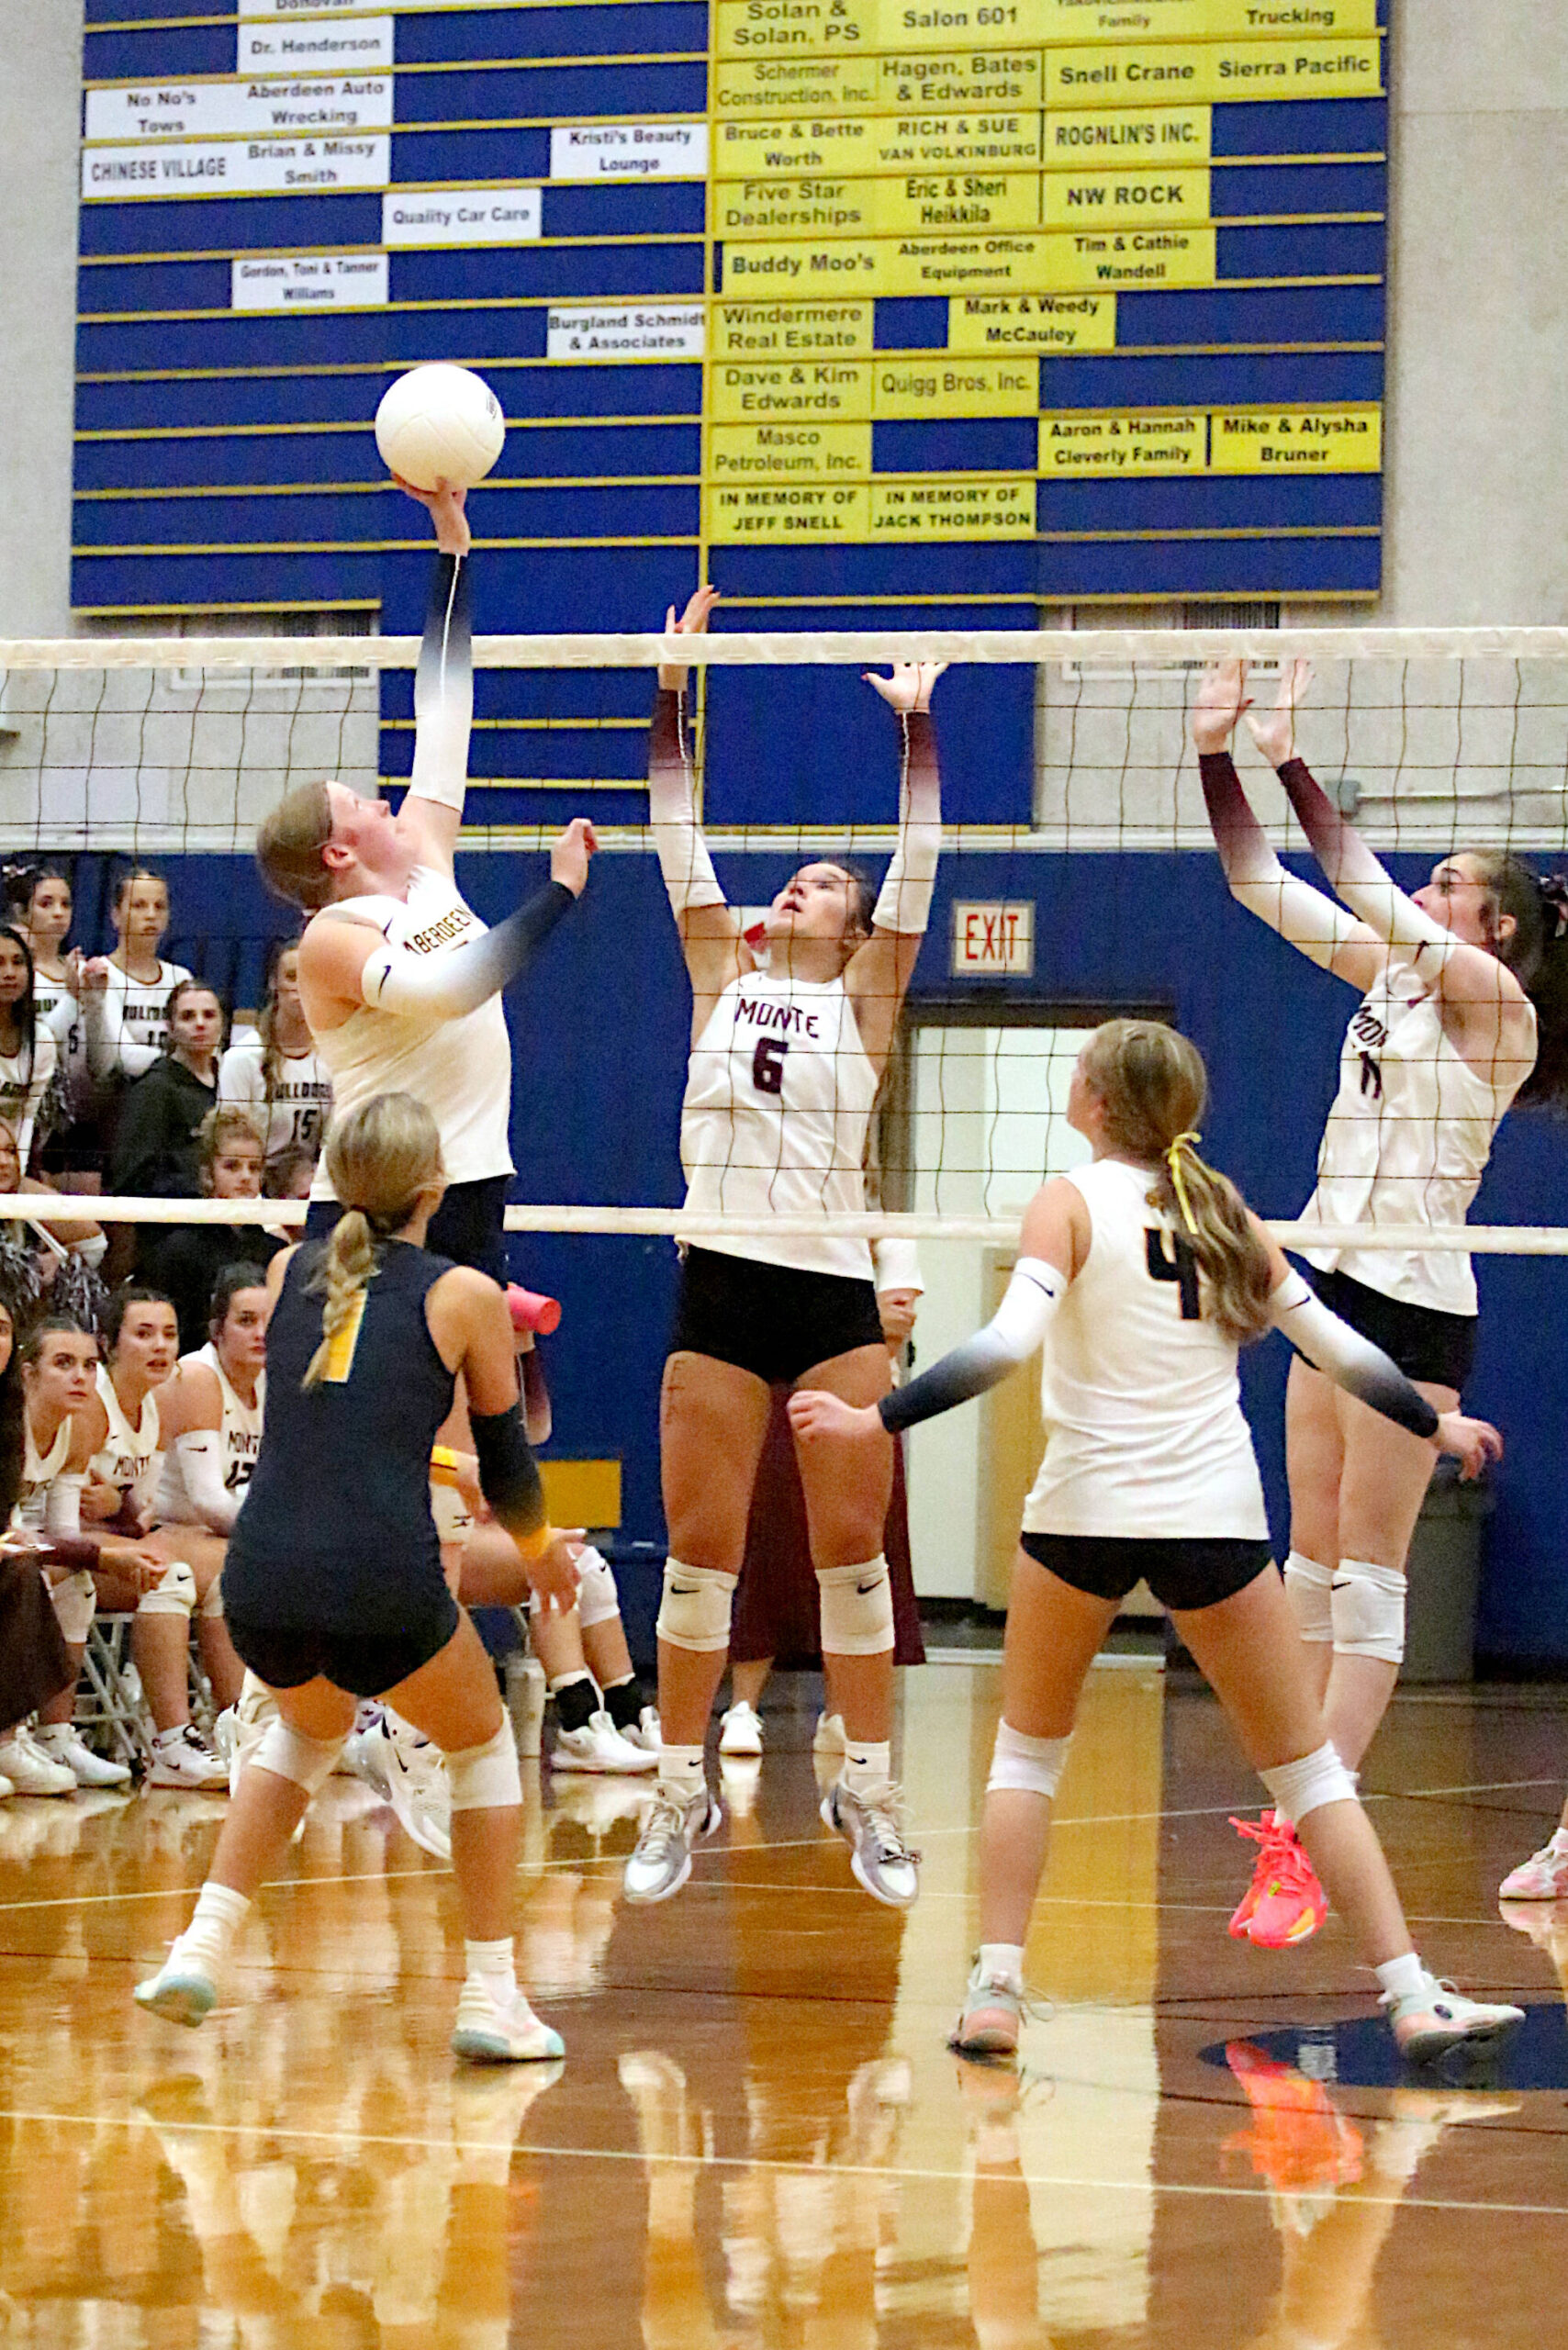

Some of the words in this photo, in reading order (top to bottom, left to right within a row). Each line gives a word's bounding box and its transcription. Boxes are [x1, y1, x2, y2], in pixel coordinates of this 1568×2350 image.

[747, 1, 821, 20] Solan
[829, 0, 847, 17] &
[903, 10, 969, 28] Salon
[977, 7, 1018, 25] 601
[1247, 9, 1335, 26] Trucking
[824, 24, 860, 41] PS
[251, 41, 274, 55] Dr.
[281, 38, 381, 54] Henderson
[755, 62, 840, 81] Schermer
[971, 56, 1036, 73] Bates
[1219, 61, 1286, 78] Sierra
[1294, 56, 1371, 73] Pacific
[1060, 66, 1117, 84] Snell
[1126, 64, 1195, 82] Crane
[248, 84, 335, 98] Aberdeen
[342, 82, 385, 95] Auto
[897, 85, 912, 102] &
[921, 83, 1024, 101] Edwards
[127, 95, 151, 107] No
[158, 92, 196, 106] No's
[138, 119, 185, 133] Tows
[271, 110, 358, 126] Wrecking
[725, 125, 782, 140] Bruce
[790, 124, 803, 138] &
[811, 123, 864, 138] Bette
[898, 121, 947, 136] RICH
[957, 120, 969, 135] &
[978, 118, 1019, 133] SUE
[1056, 125, 1155, 146] ROGNLIN'S
[1162, 123, 1199, 143] INC.
[569, 130, 627, 146] Kristi's
[633, 129, 691, 145] Beauty
[248, 144, 297, 160] Brian
[304, 144, 316, 157] &
[323, 142, 375, 158] Missy
[765, 151, 823, 166] Worth
[879, 148, 914, 161] VAN
[921, 143, 1036, 160] VOLKINBURG
[92, 160, 156, 182] CHINESE
[162, 157, 226, 178] VILLAGE
[599, 157, 660, 174] Lounge
[285, 170, 337, 184] Smith
[744, 185, 790, 201] Five
[798, 184, 844, 199] Star
[906, 179, 938, 198] Eric
[945, 179, 957, 196] &
[964, 178, 1007, 197] Sheri
[1067, 188, 1106, 206] NW
[1114, 185, 1183, 204] ROCK
[393, 209, 452, 227] Quality
[457, 208, 486, 222] Car
[491, 207, 531, 221] Care
[726, 208, 862, 227] Dealerships
[921, 205, 991, 225] Heikkila
[899, 241, 979, 256] Aberdeen
[985, 240, 1035, 253] Office
[1074, 237, 1106, 252] Tim
[1113, 237, 1126, 252] &
[1132, 235, 1189, 252] Cathie
[294, 263, 319, 274] Toni
[322, 263, 331, 274] &
[336, 261, 378, 274] Tanner
[732, 255, 801, 276] Buddy
[810, 252, 875, 271] Moo's
[921, 264, 1011, 281] Equipment
[1096, 263, 1166, 279] Wandell
[283, 287, 335, 300] Williams
[965, 299, 1010, 315] Mark
[1019, 298, 1031, 313] &
[634, 313, 706, 327] Schmidt
[722, 308, 862, 323] Windermere
[569, 337, 582, 350] &
[588, 335, 686, 351] Associates
[728, 332, 777, 349] Real
[786, 330, 857, 348] Estate
[986, 327, 1077, 344] McCauley
[725, 369, 781, 386] Dave
[790, 368, 805, 386] &
[814, 367, 858, 384] Kim
[881, 373, 936, 396] Quigg
[742, 393, 841, 410] Edwards
[1050, 423, 1102, 438] Aaron
[1109, 422, 1120, 435] &
[1128, 420, 1195, 434] Hannah
[1224, 419, 1271, 434] Mike
[1278, 418, 1292, 433] &
[1299, 418, 1368, 436] Alysha
[756, 430, 821, 445] Masco
[1054, 448, 1126, 465] Cleverly
[1133, 446, 1191, 464] Family
[1261, 447, 1329, 462] Bruner
[721, 492, 739, 505] IN
[745, 491, 824, 506] MEMORY
[833, 490, 857, 504] OF
[886, 490, 904, 504] IN
[911, 488, 990, 503] MEMORY
[996, 487, 1019, 501] OF
[734, 517, 776, 531] JEFF
[783, 515, 842, 530] SNELL
[874, 513, 922, 528] JACK
[929, 512, 1030, 527] THOMPSON
[966, 914, 1018, 959] EXIT
[734, 998, 820, 1038] MONTE
[68, 1024, 79, 1054] 6
[753, 1036, 789, 1093] 6
[291, 1109, 318, 1141] 15
[1144, 1226, 1201, 1319] 4
[229, 1430, 263, 1455] MONT
